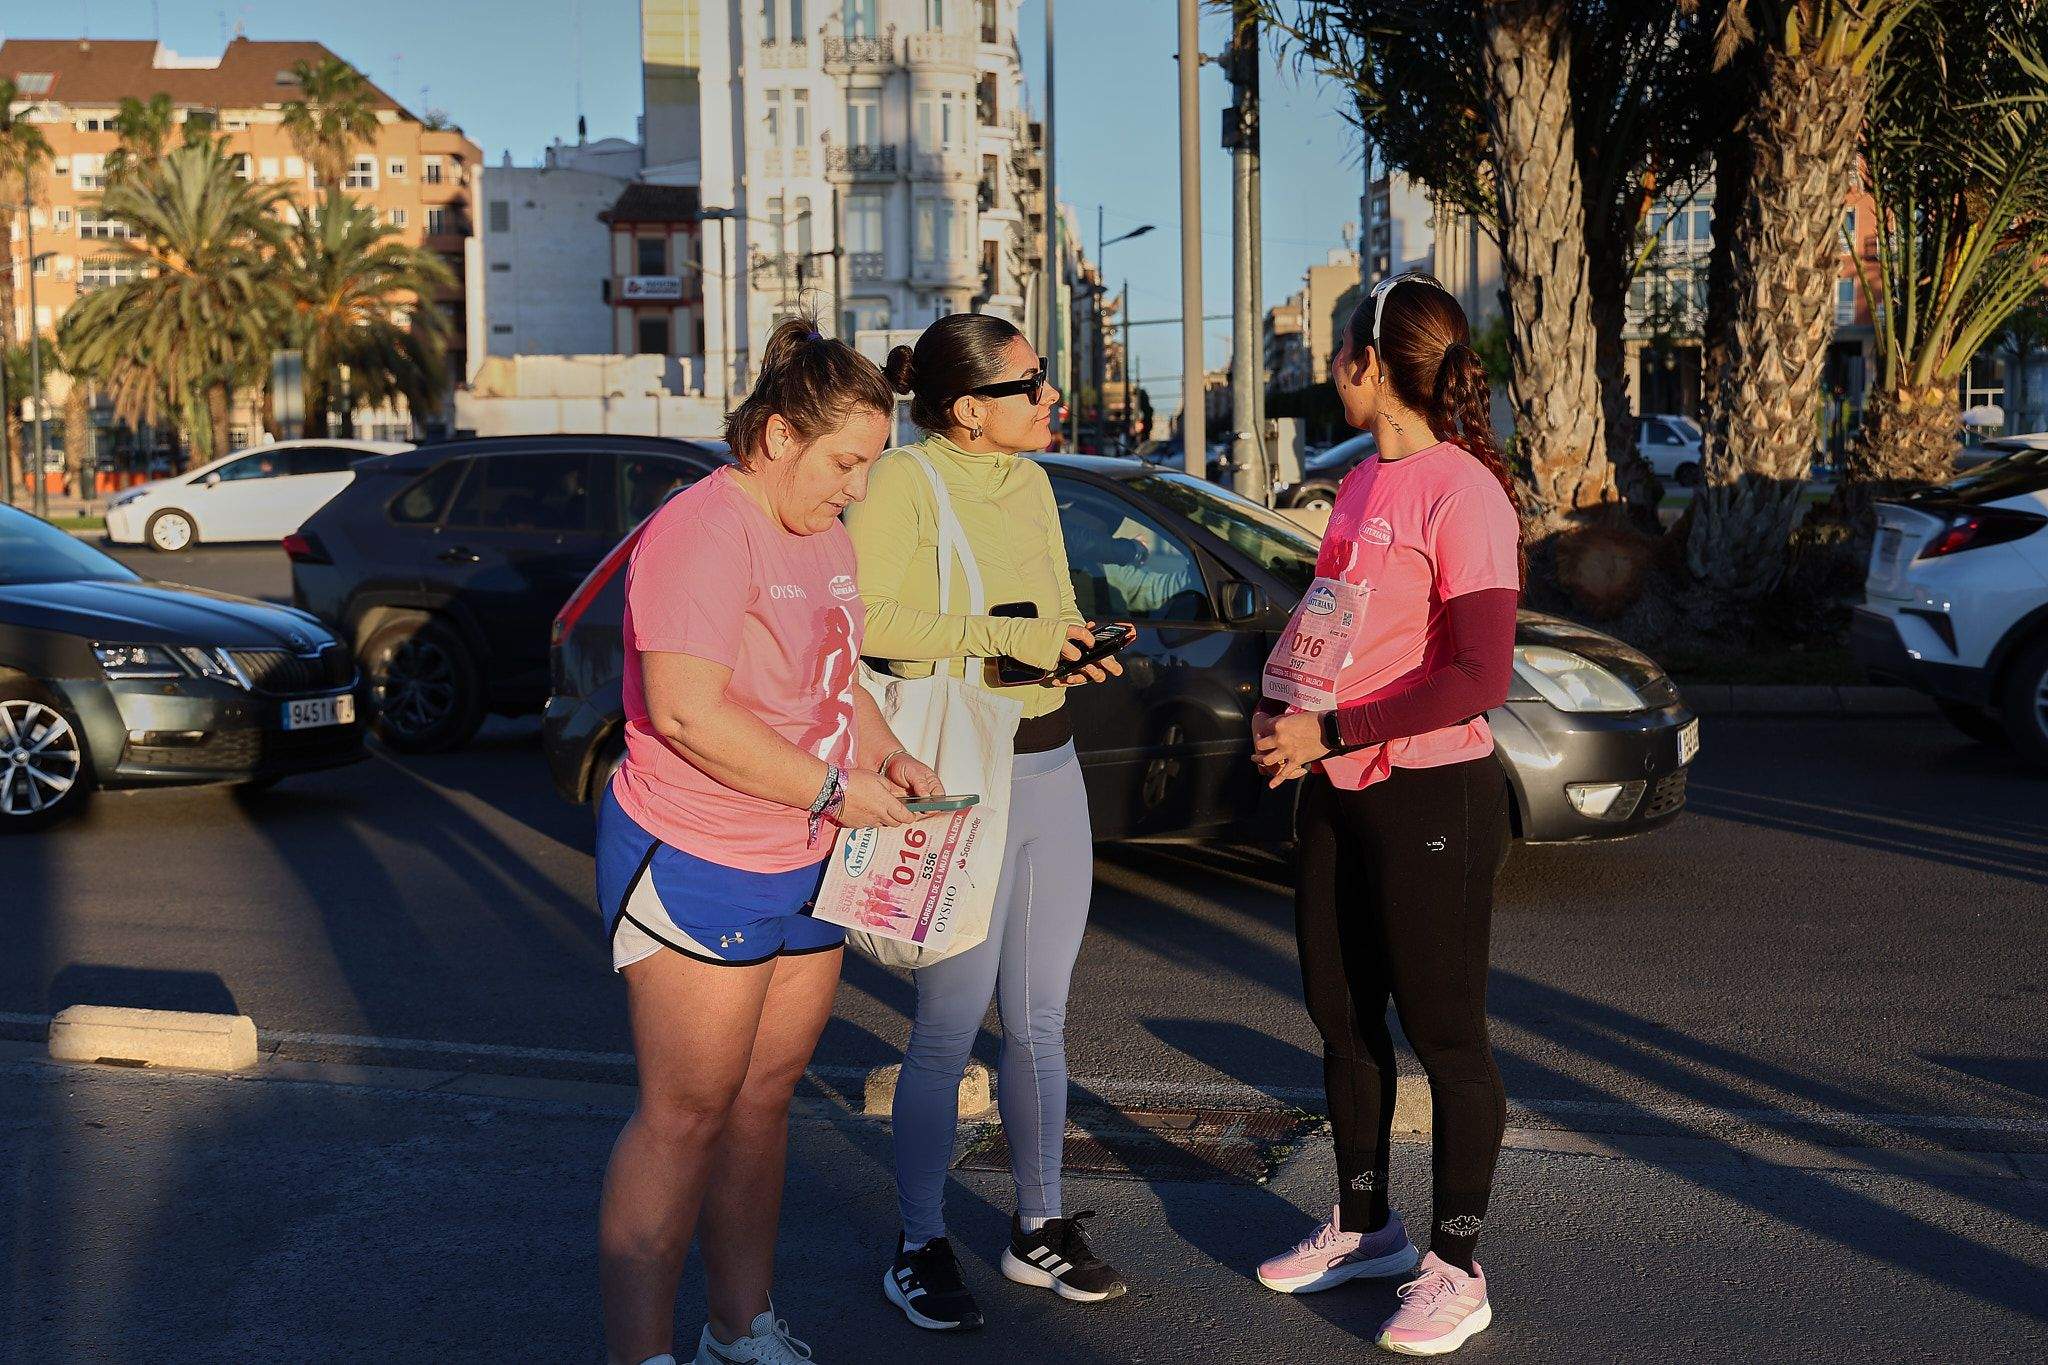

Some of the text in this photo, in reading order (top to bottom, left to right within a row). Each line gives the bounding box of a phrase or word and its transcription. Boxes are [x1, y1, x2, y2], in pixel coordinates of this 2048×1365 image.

[1291, 632, 1325, 657] 016
[948, 815, 964, 844] VALENCIA
[850, 826, 873, 873] ASTURIAN
[892, 829, 926, 885] 016
[938, 850, 951, 873] MUJER
[922, 853, 937, 879] 5356
[934, 873, 943, 884] LA
[935, 818, 981, 933] OYSHO Santander
[931, 883, 940, 894] DE
[920, 895, 936, 926] CARRERA
